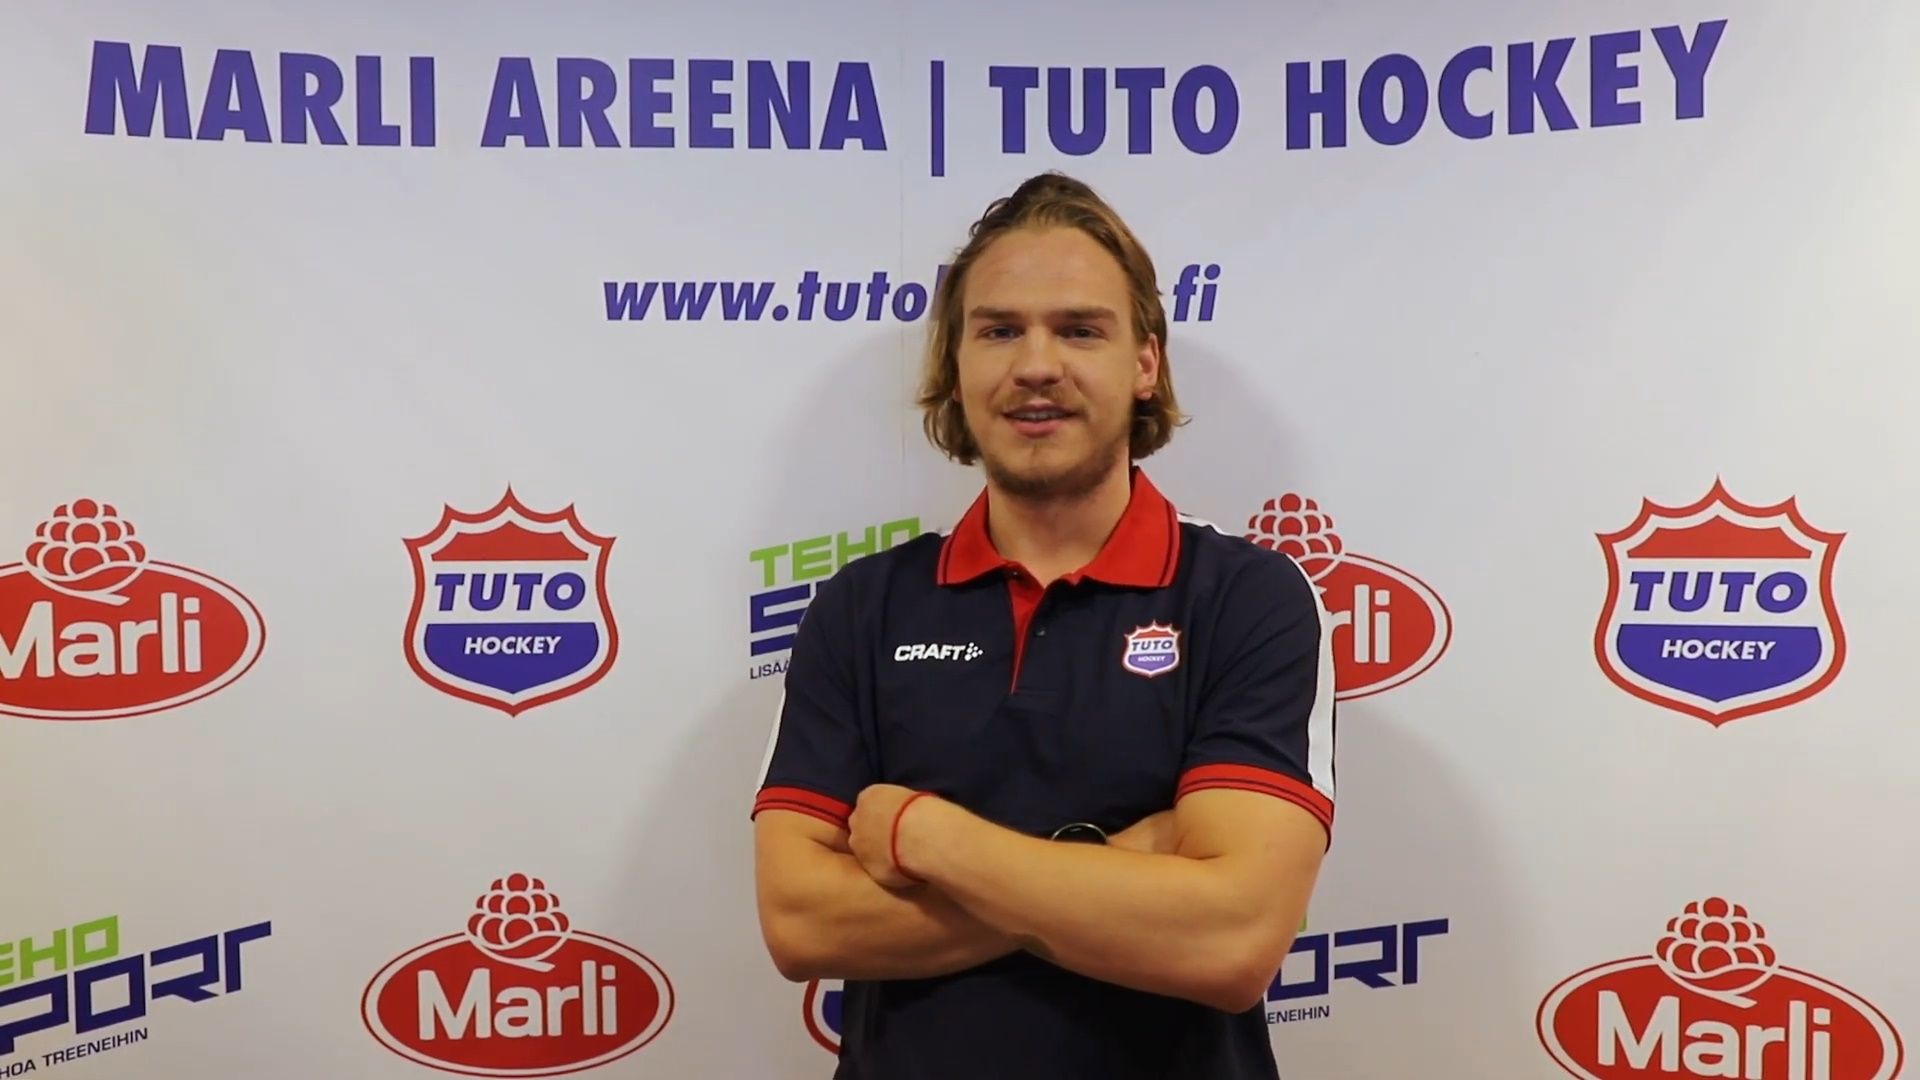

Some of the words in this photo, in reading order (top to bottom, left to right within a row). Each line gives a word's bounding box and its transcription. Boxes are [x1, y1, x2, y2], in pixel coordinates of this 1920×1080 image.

[84, 40, 436, 148] MARLI
[480, 56, 887, 151] AREENA
[989, 65, 1240, 156] TUTO
[1286, 20, 1728, 151] HOCKEY
[435, 572, 586, 611] TUTO
[1630, 571, 1808, 613] TUTO
[464, 636, 562, 655] HOCKEY
[1132, 640, 1173, 651] TUTO
[1325, 584, 1390, 664] rli
[1661, 639, 1777, 661] HOCKEY
[894, 643, 966, 661] CRAFT
[0, 915, 119, 986] HO
[1267, 918, 1449, 1002] ORT
[0, 921, 271, 1056] PORT
[417, 960, 618, 1040] Marli
[1267, 1005, 1330, 1024] ENEIHIN
[0, 1059, 36, 1079] HOA
[42, 1027, 148, 1067] TREENEIHIN
[1598, 990, 1831, 1080] Marli
